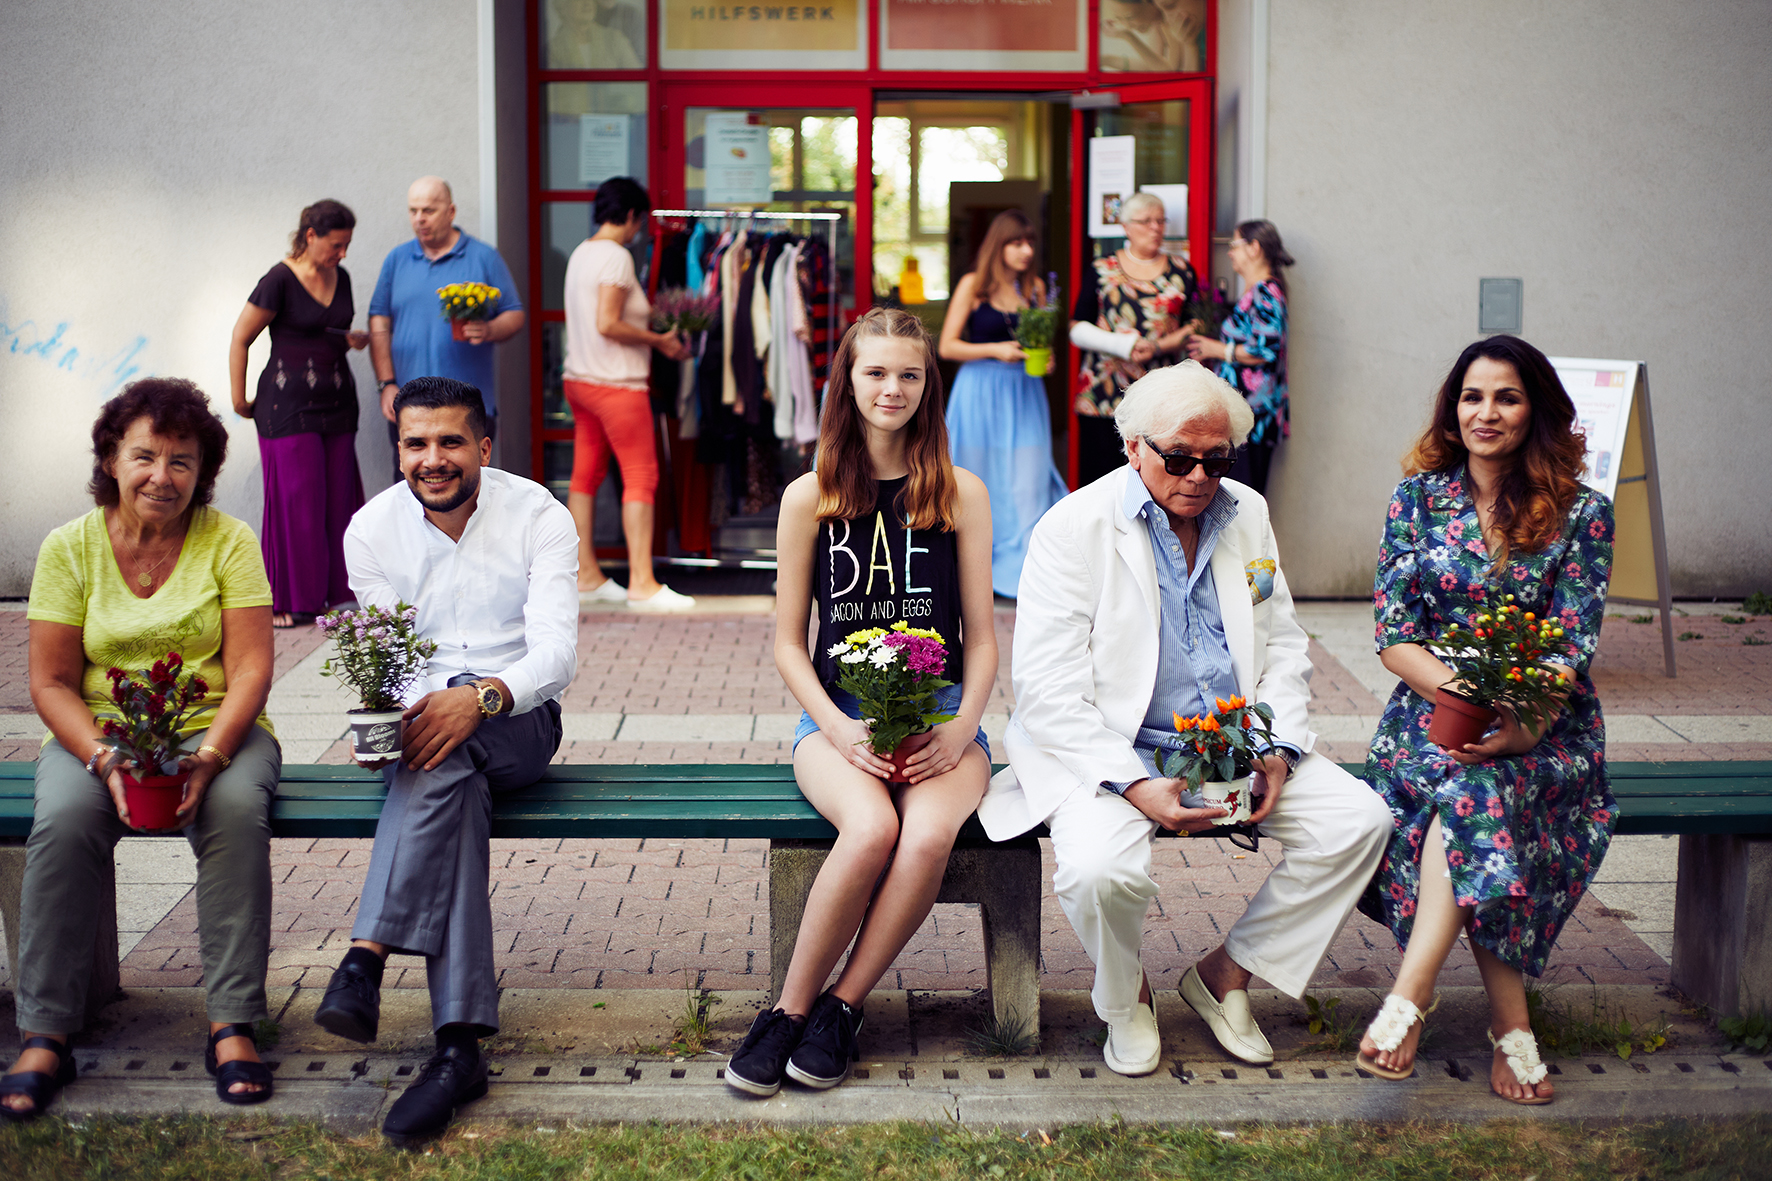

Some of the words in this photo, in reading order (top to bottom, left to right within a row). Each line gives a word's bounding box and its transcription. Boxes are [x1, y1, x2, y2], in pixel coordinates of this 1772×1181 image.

[690, 6, 835, 21] HILFSWERK
[828, 510, 932, 599] BAE
[870, 600, 896, 620] AND
[902, 598, 932, 618] EGGS
